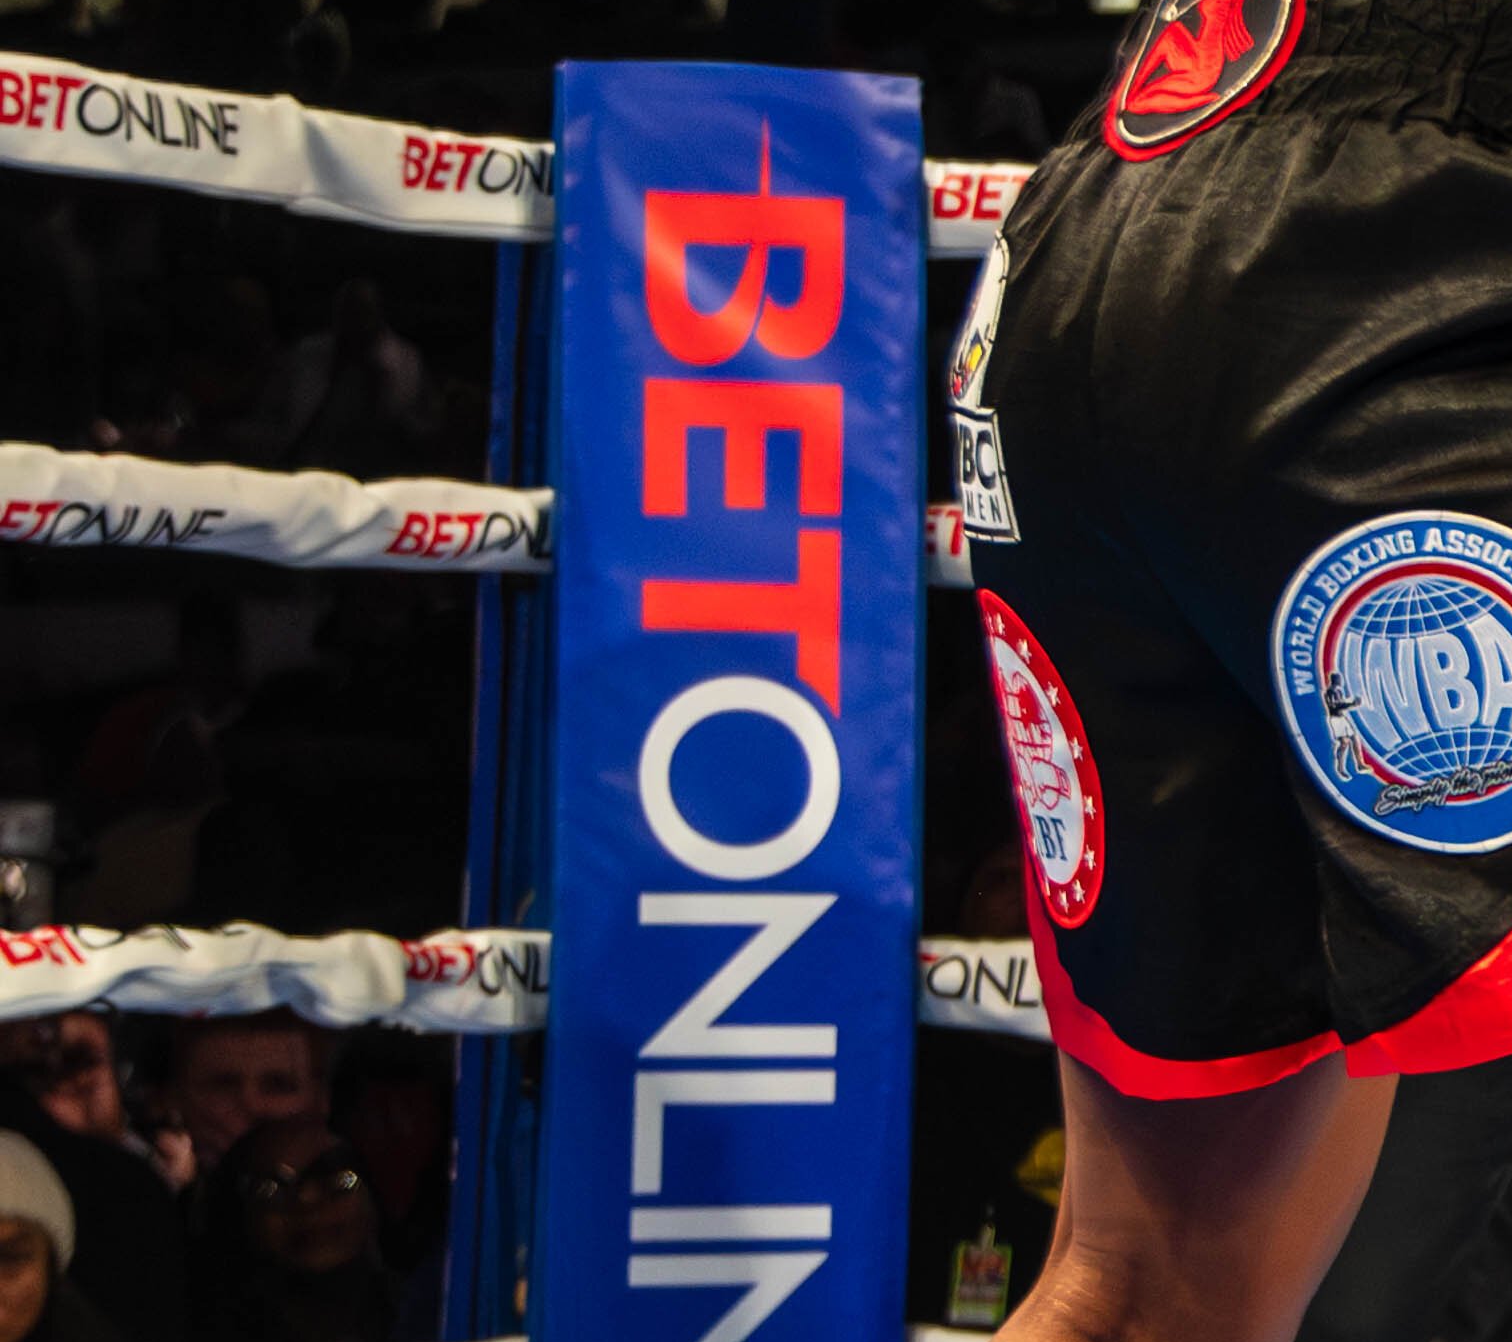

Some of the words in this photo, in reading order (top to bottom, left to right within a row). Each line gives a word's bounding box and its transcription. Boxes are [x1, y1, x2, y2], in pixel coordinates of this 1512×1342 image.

[0, 71, 241, 156] BETONLINE
[957, 422, 999, 491] BC
[1286, 597, 1326, 697] WORLD
[1321, 529, 1417, 600] BOXING
